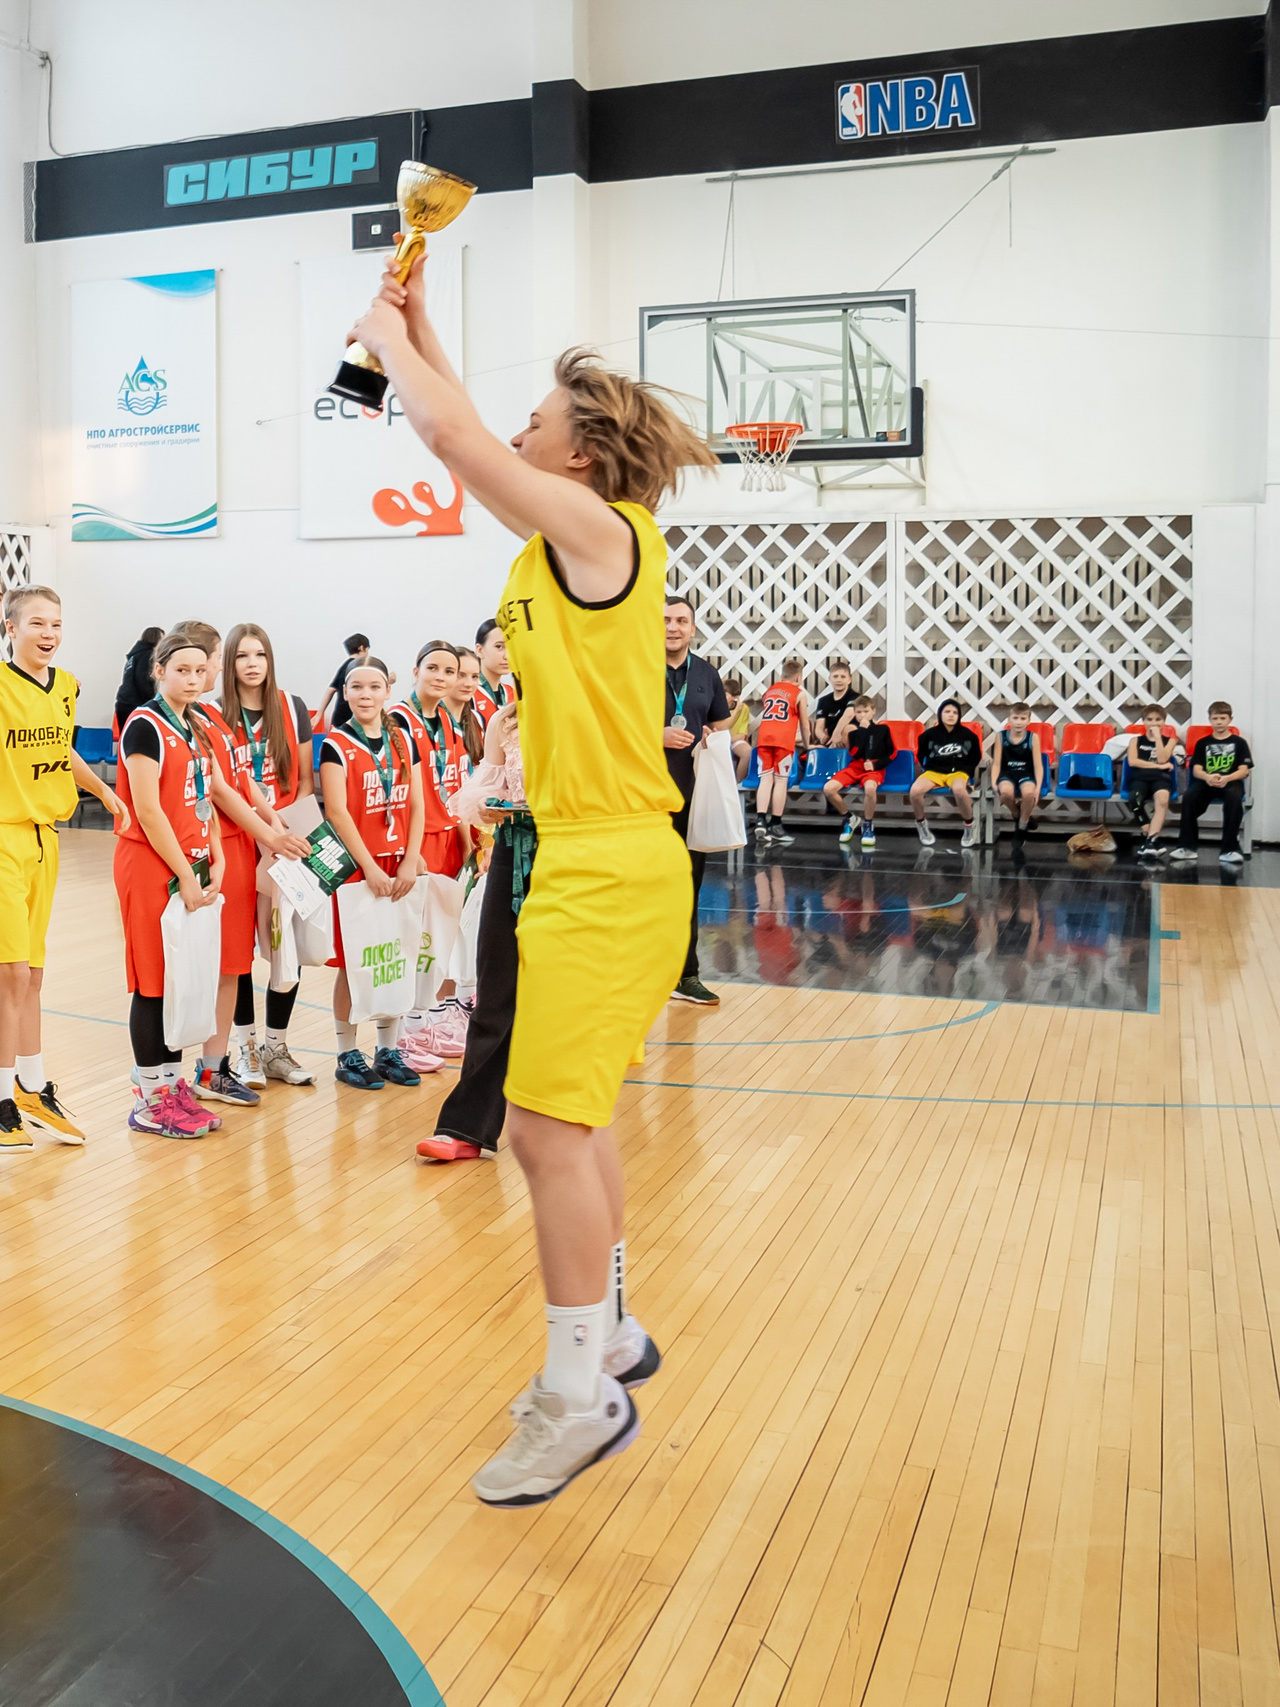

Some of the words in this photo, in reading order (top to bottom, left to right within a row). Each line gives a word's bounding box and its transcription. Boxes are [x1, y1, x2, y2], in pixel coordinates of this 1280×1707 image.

[866, 72, 976, 136] NBA
[166, 139, 377, 206] СИБУР
[86, 429, 106, 440] НПО
[108, 422, 200, 439] АГРОСТРОЙСЕРВИС
[762, 698, 789, 721] 23
[372, 958, 407, 988] БАСКЕТ
